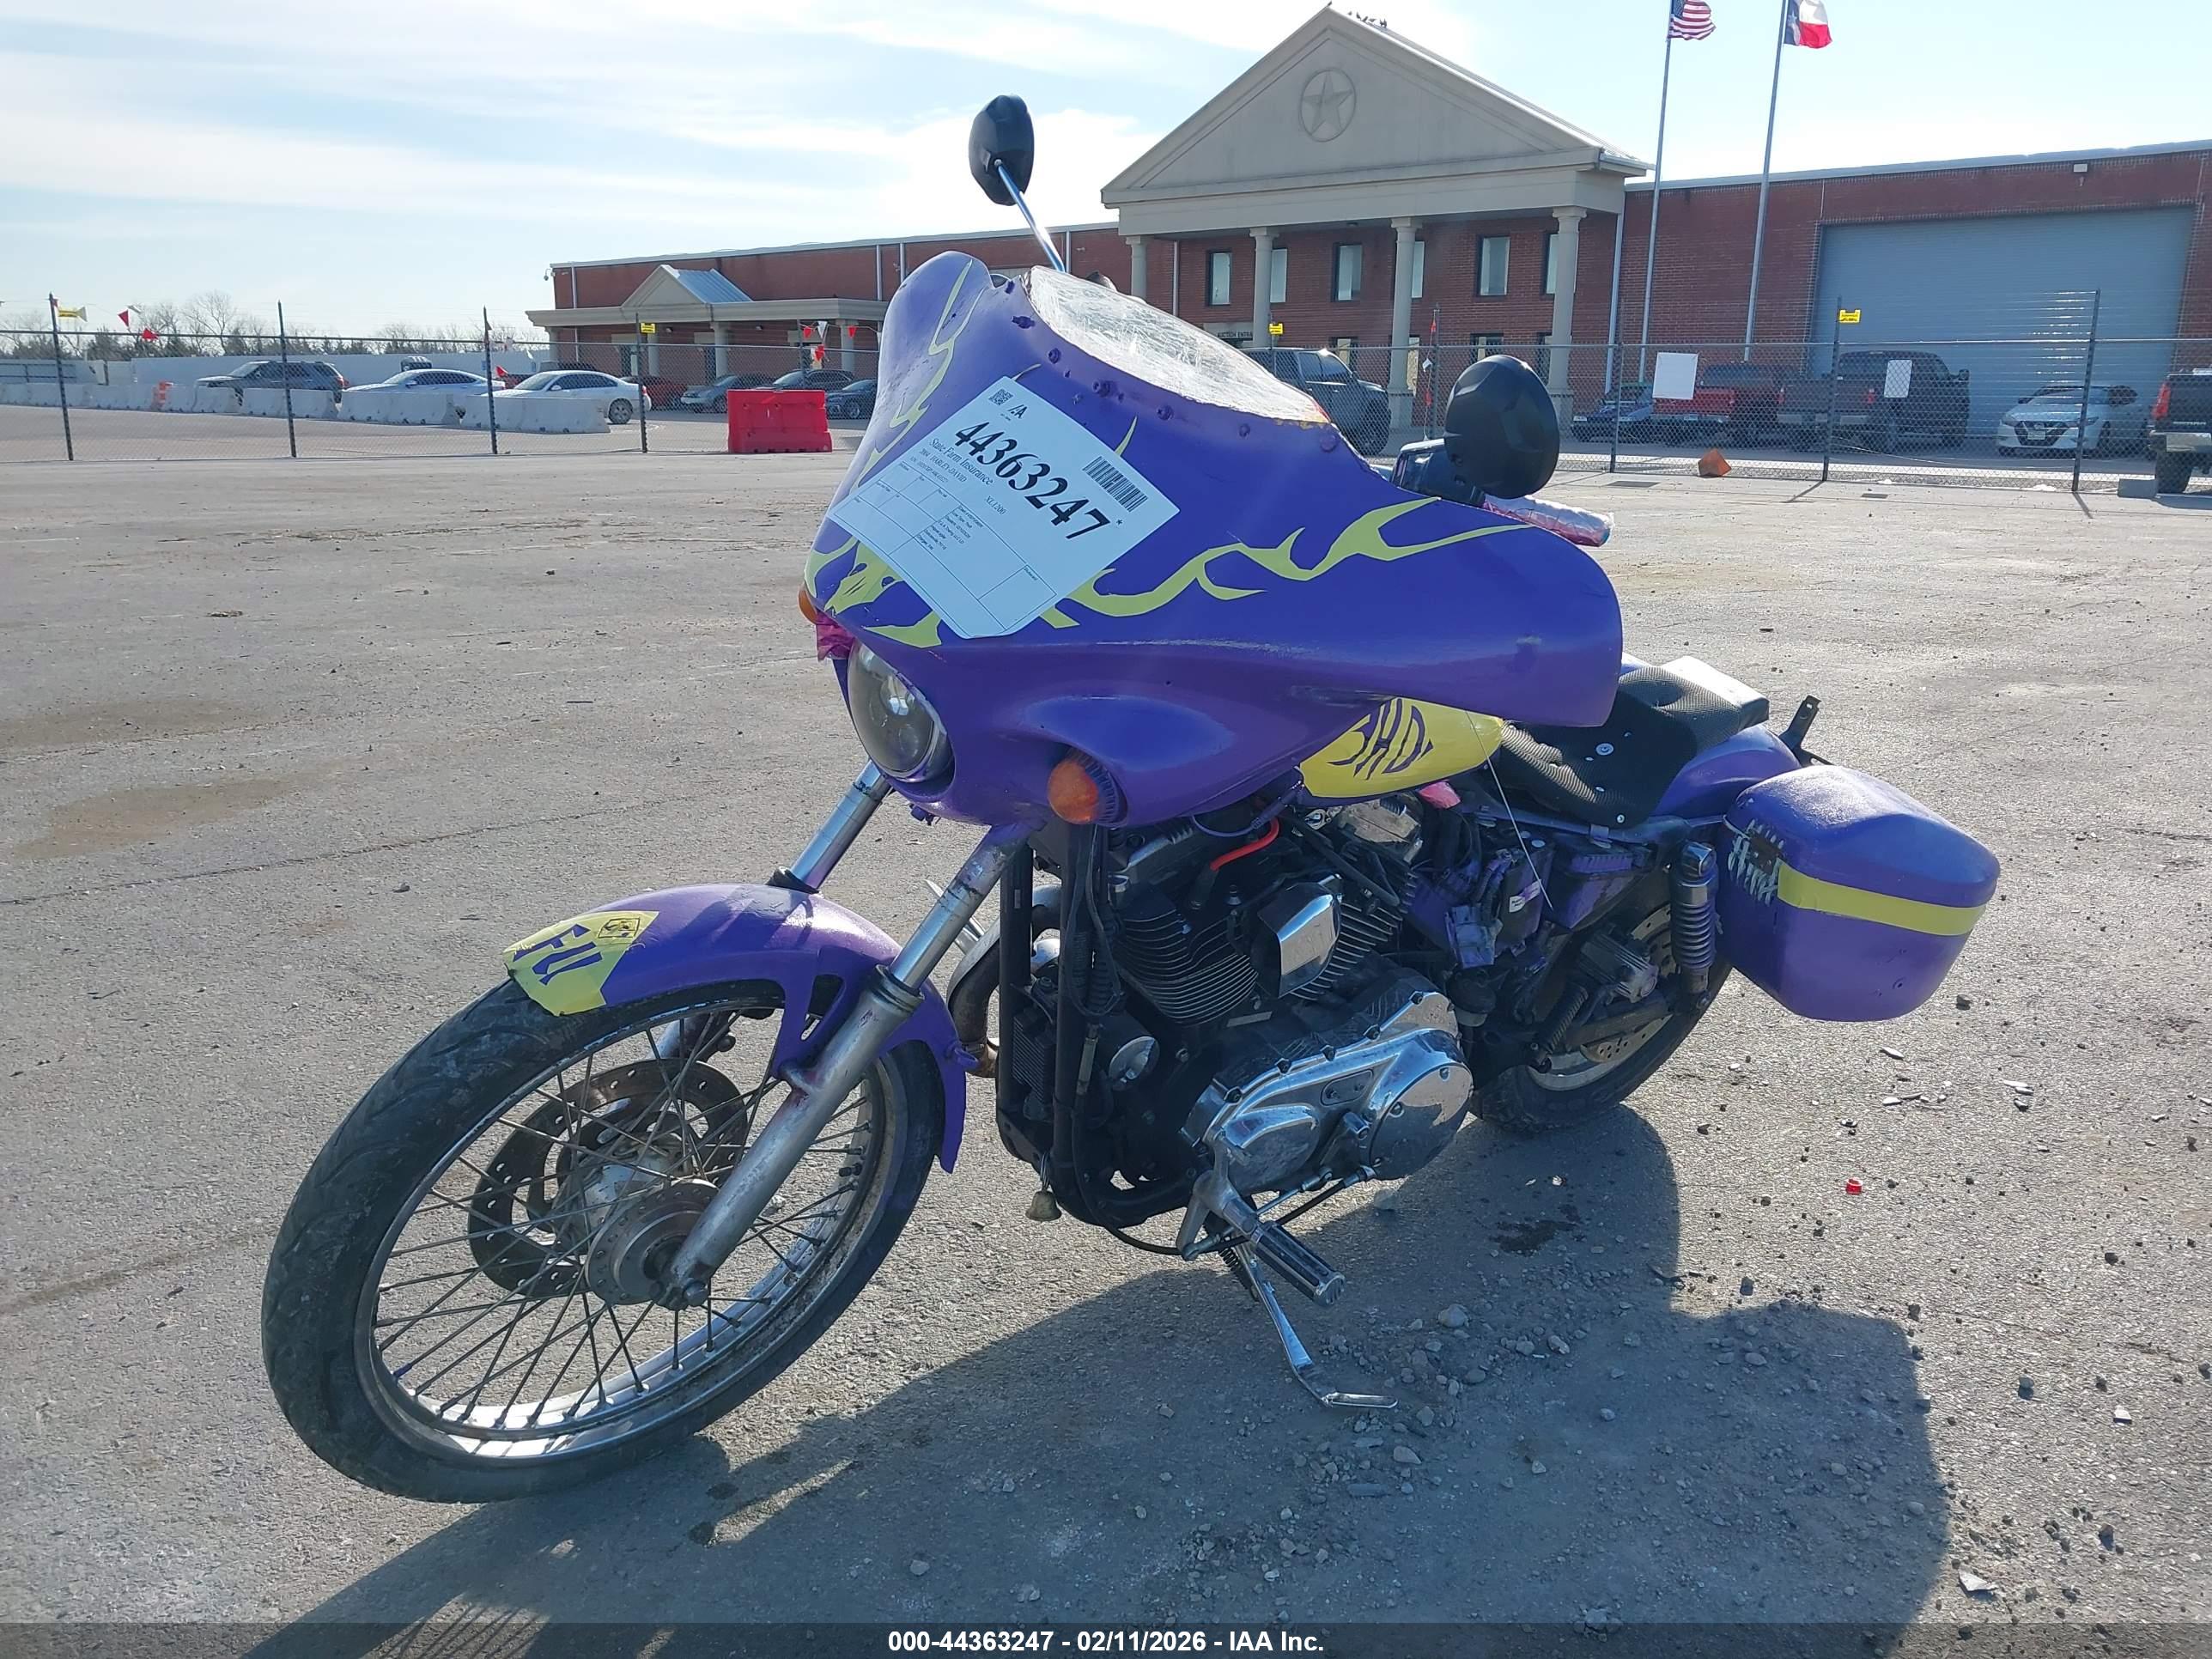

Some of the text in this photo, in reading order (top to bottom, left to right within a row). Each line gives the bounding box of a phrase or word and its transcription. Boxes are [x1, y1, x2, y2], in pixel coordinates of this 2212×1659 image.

[929, 438, 946, 453] State
[944, 446, 963, 464] Farm
[959, 457, 994, 486] Insurance
[955, 422, 1111, 539] 44363247
